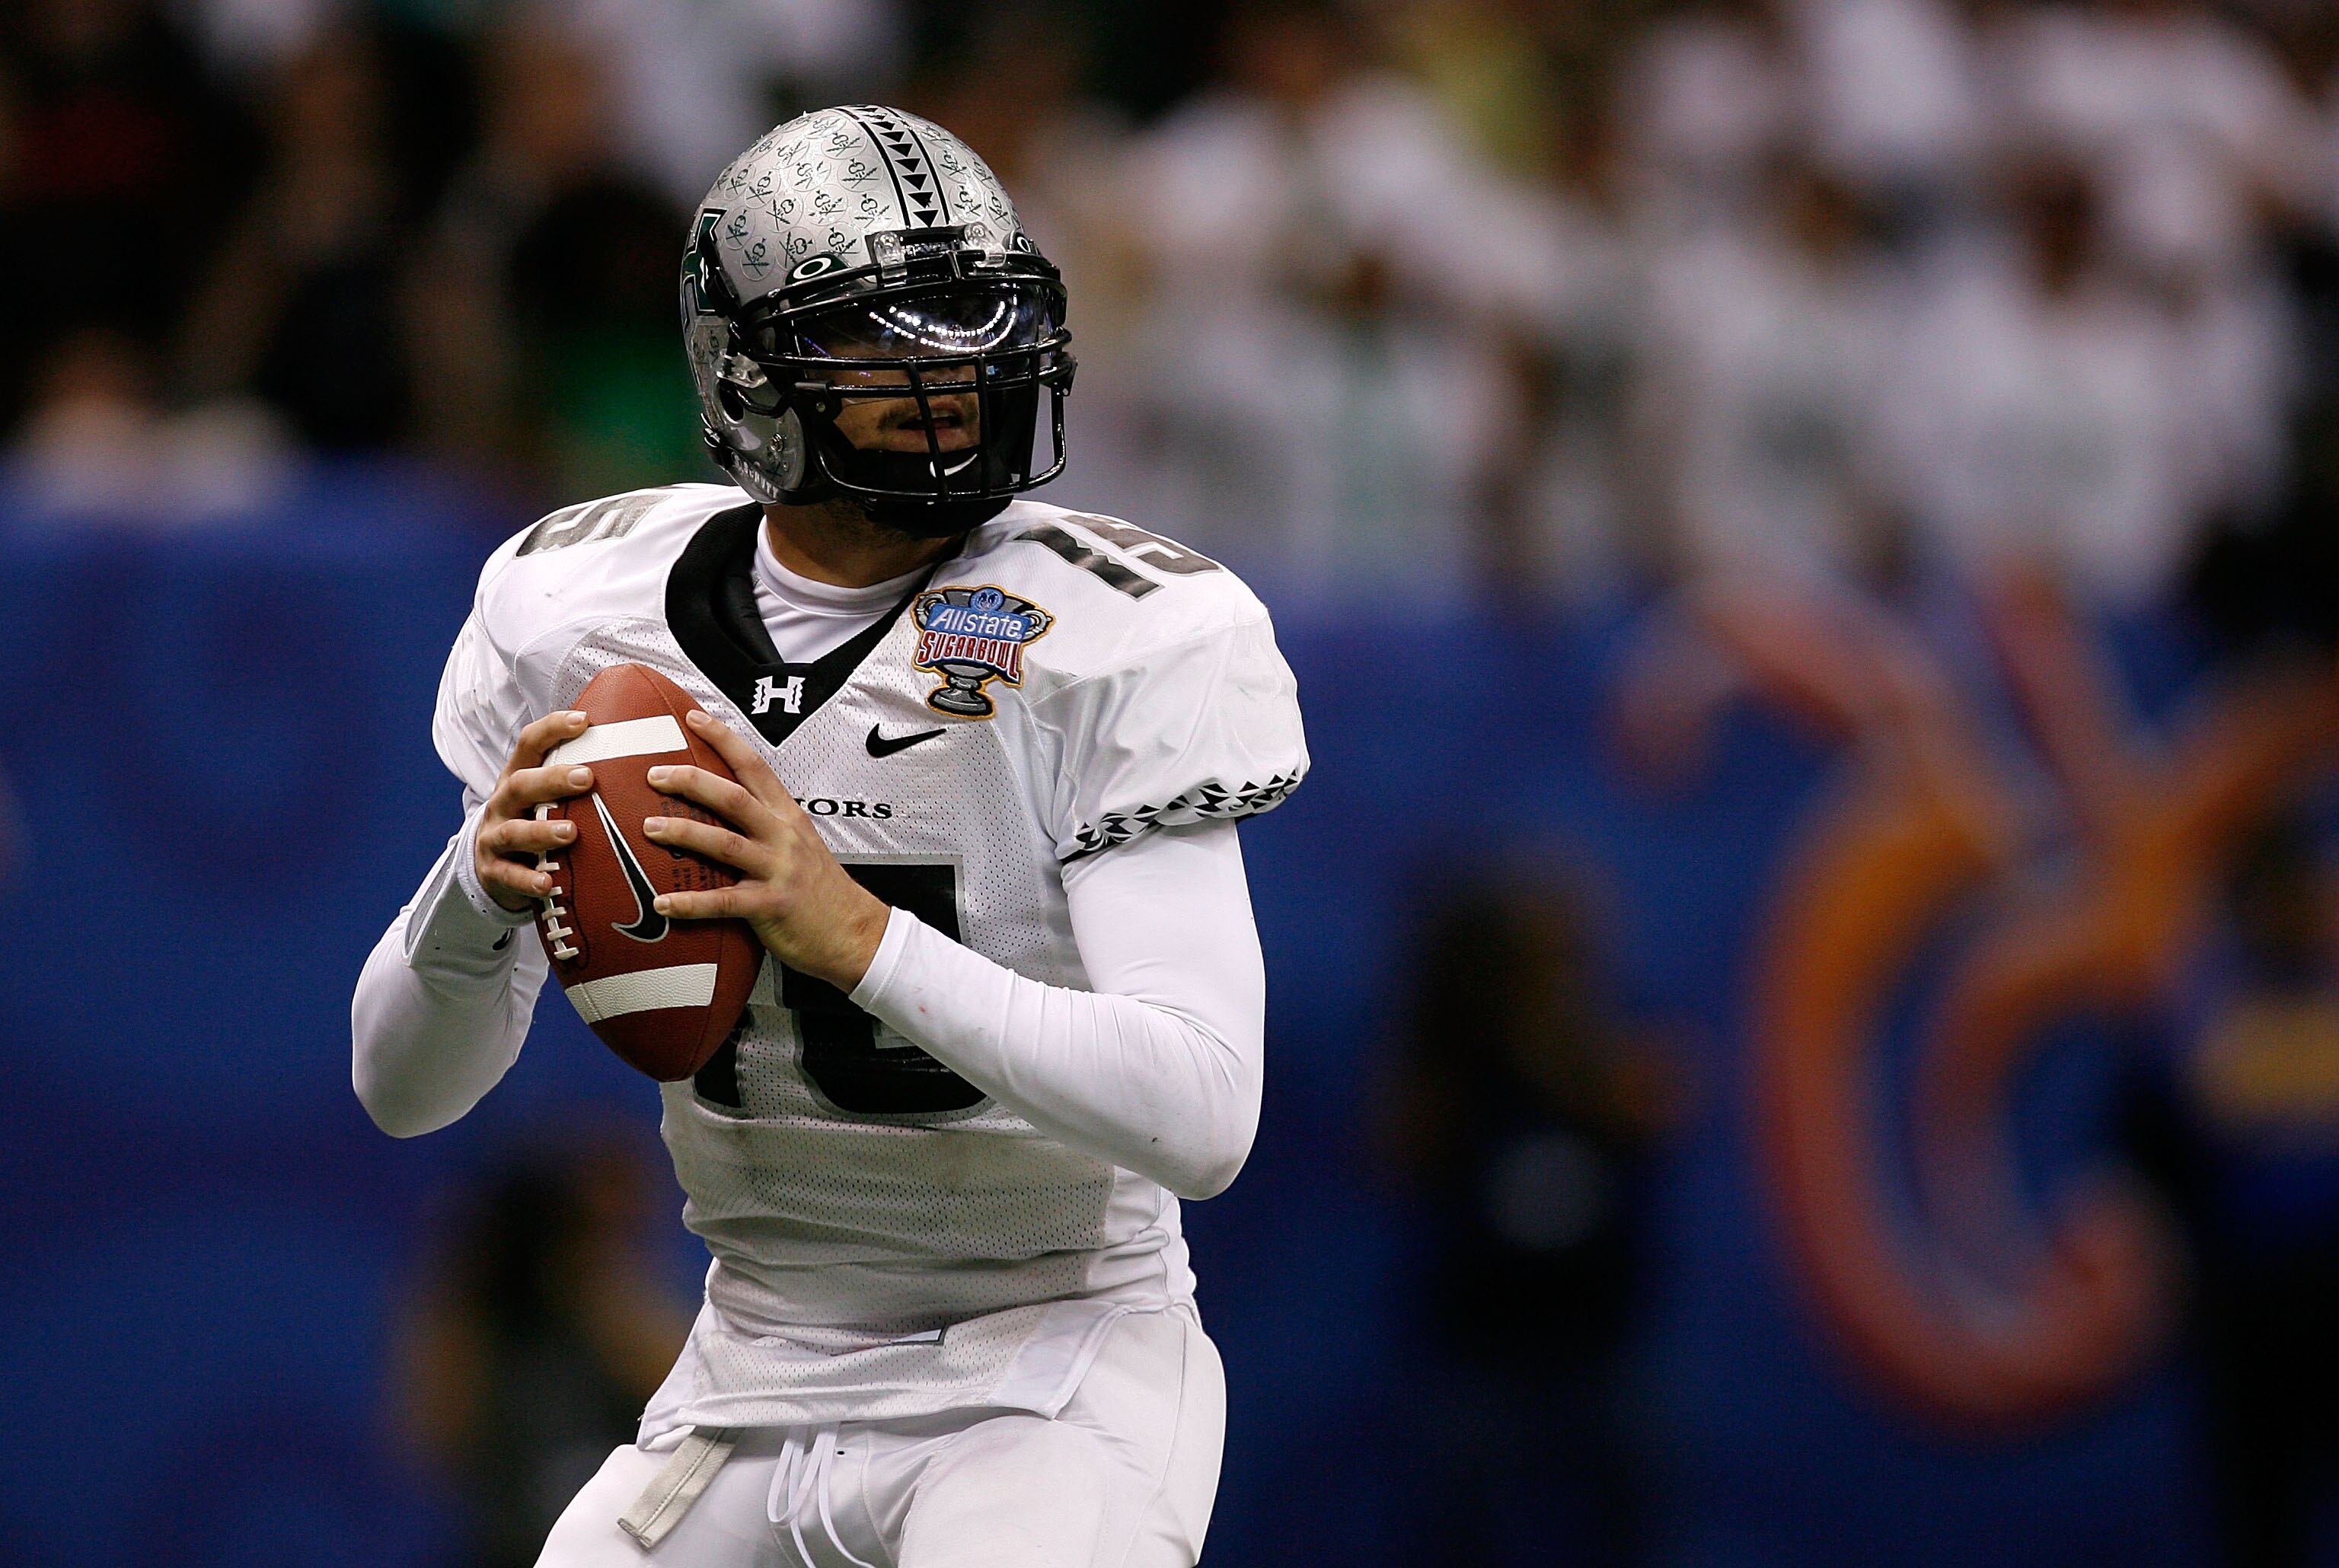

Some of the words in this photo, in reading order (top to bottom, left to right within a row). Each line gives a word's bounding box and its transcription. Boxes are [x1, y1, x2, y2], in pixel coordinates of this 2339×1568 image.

[1013, 515, 1222, 601] 15
[930, 607, 1023, 639] Allstate
[751, 675, 806, 715] H
[793, 798, 892, 820] ORS
